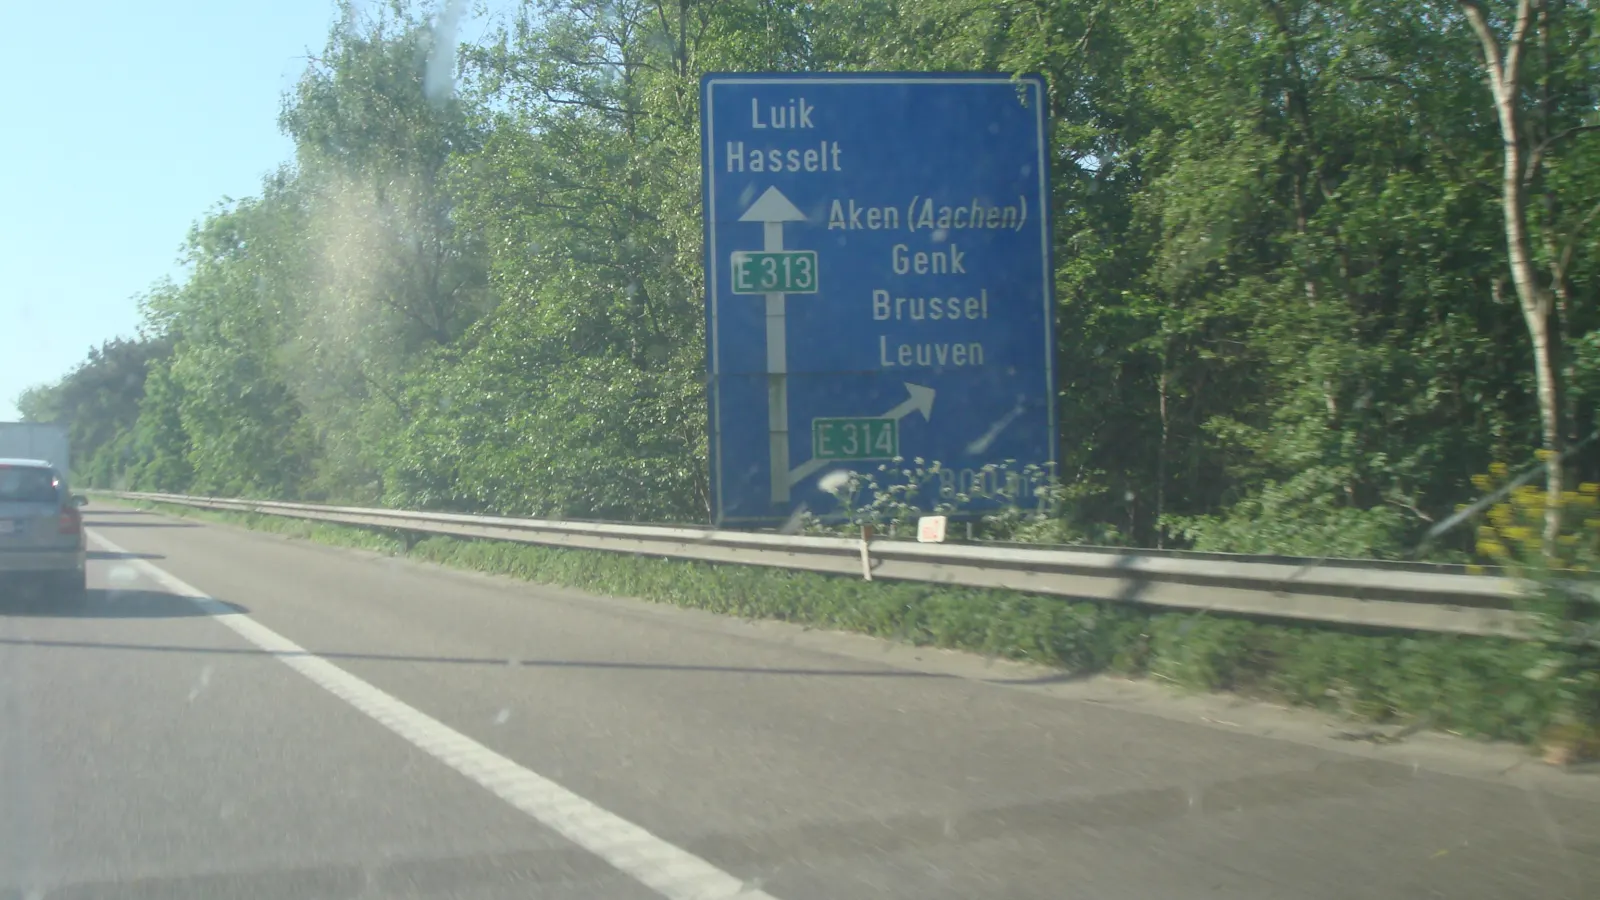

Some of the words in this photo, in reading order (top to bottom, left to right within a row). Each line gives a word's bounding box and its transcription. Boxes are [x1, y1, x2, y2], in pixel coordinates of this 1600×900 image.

[751, 97, 815, 129] Luik
[726, 141, 842, 172] Hasselt
[828, 198, 899, 230] Aken
[907, 195, 1028, 232] (Aachen)
[761, 256, 812, 289] 313
[892, 243, 966, 274] Genk
[872, 288, 988, 321] Brussel
[879, 335, 984, 367] Leuven
[842, 422, 893, 455] 314
